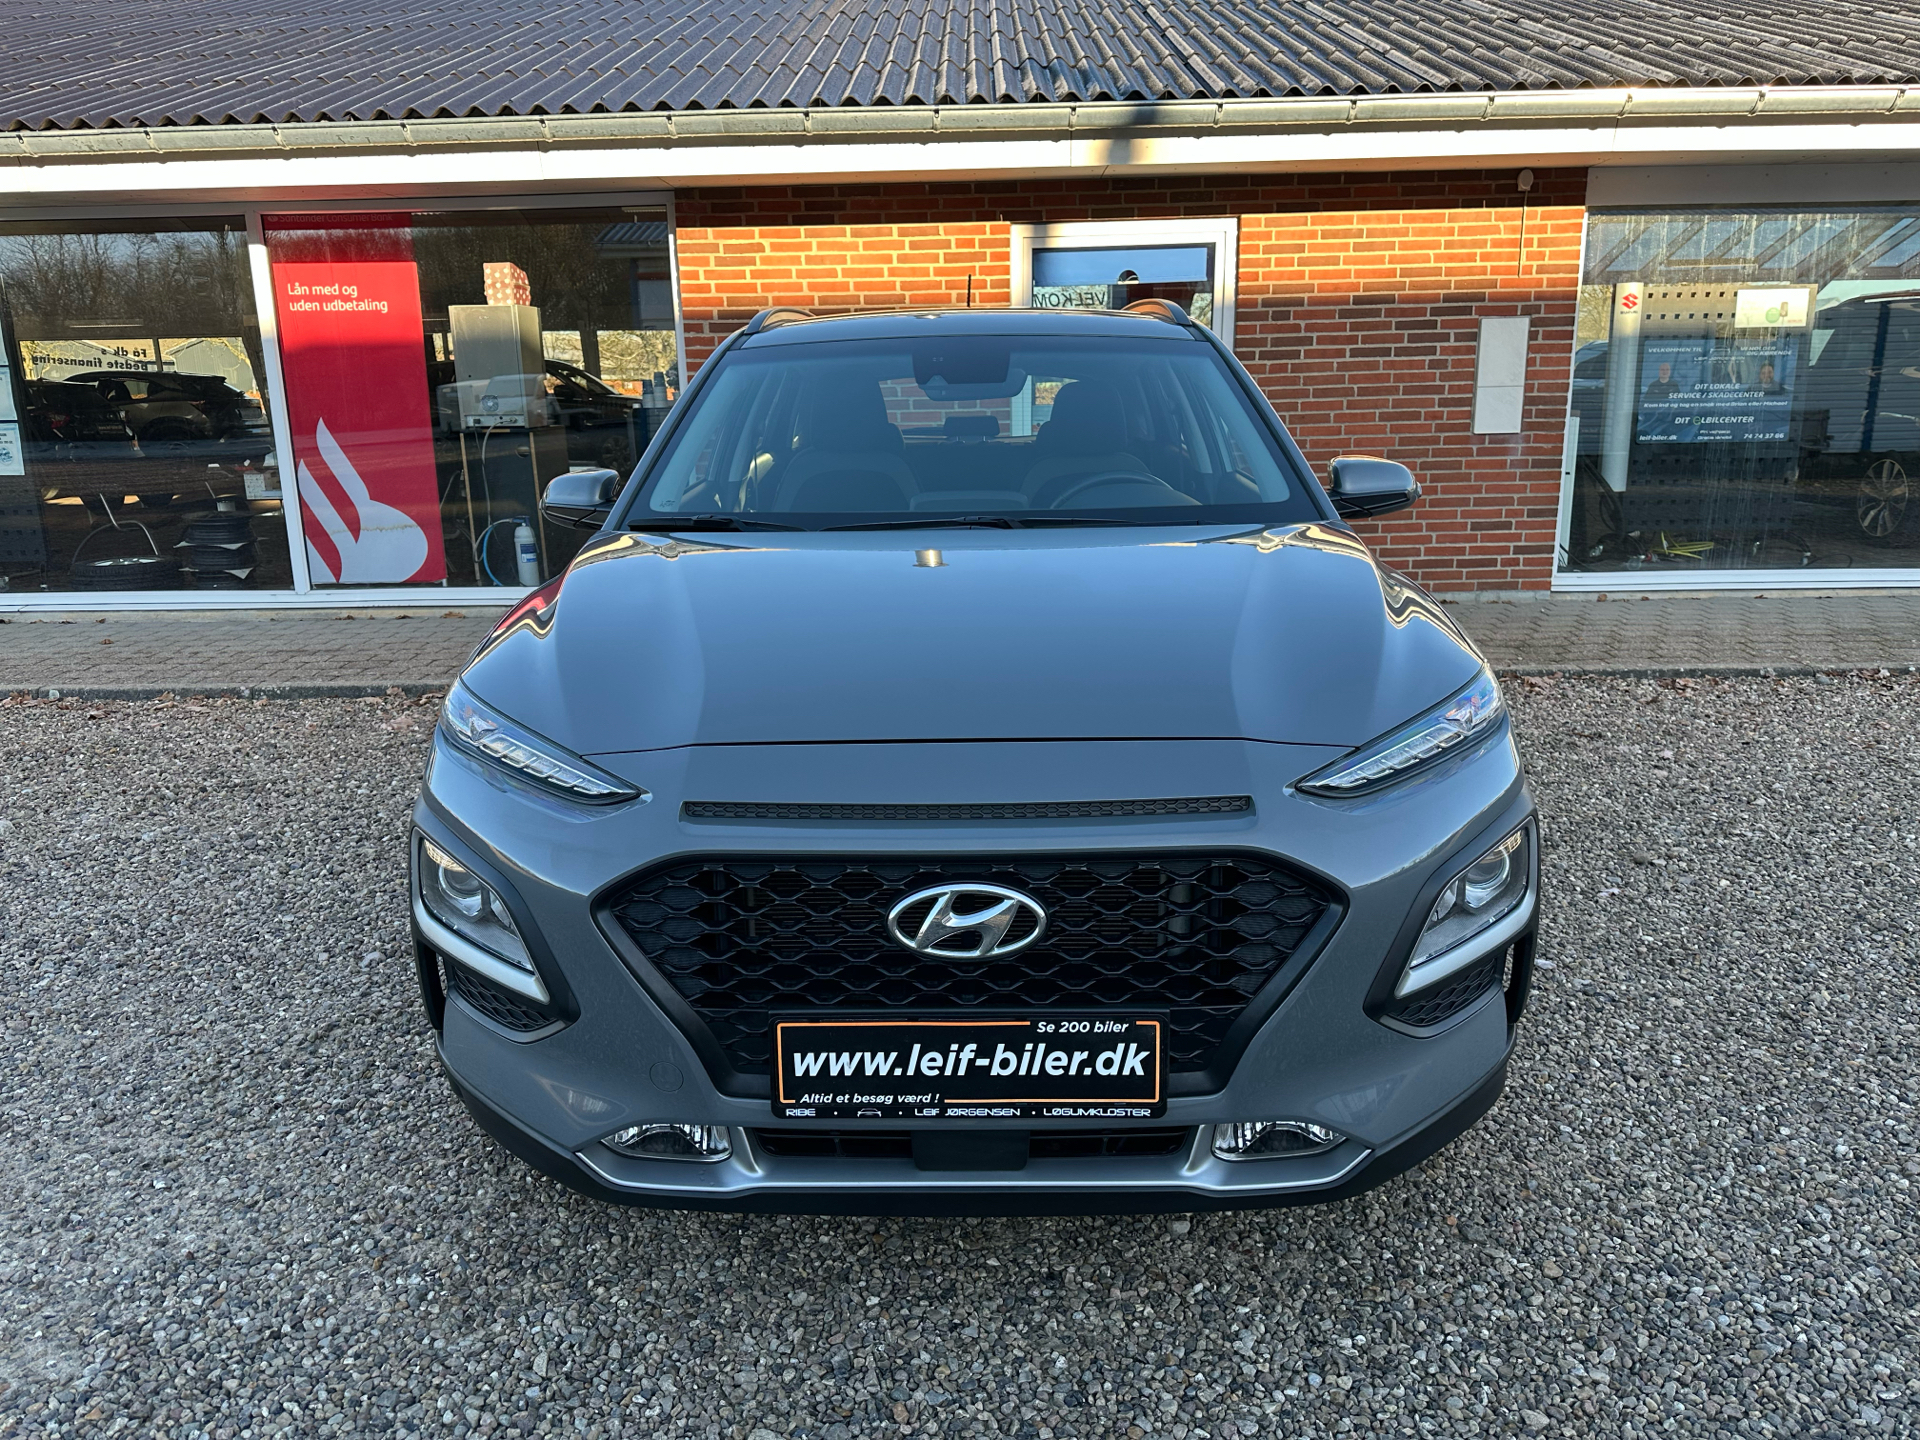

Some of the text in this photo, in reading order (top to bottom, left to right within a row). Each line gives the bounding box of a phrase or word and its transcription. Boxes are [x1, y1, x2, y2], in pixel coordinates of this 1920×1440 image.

[280, 214, 325, 223] Santander
[287, 282, 358, 298] Lån med og
[289, 298, 388, 314] uden udbetaling
[1674, 416, 1691, 424] DIT
[1036, 1021, 1129, 1033] Se 200 biler
[793, 1043, 1151, 1077] www.leif-biler.dk
[799, 1093, 834, 1104] Altid
[835, 1094, 851, 1104] et
[852, 1093, 894, 1105] besøg
[897, 1093, 932, 1104] værd
[785, 1107, 1152, 1117] RIBE LEIF JØRGENSEN LØGUMKLOSTER
